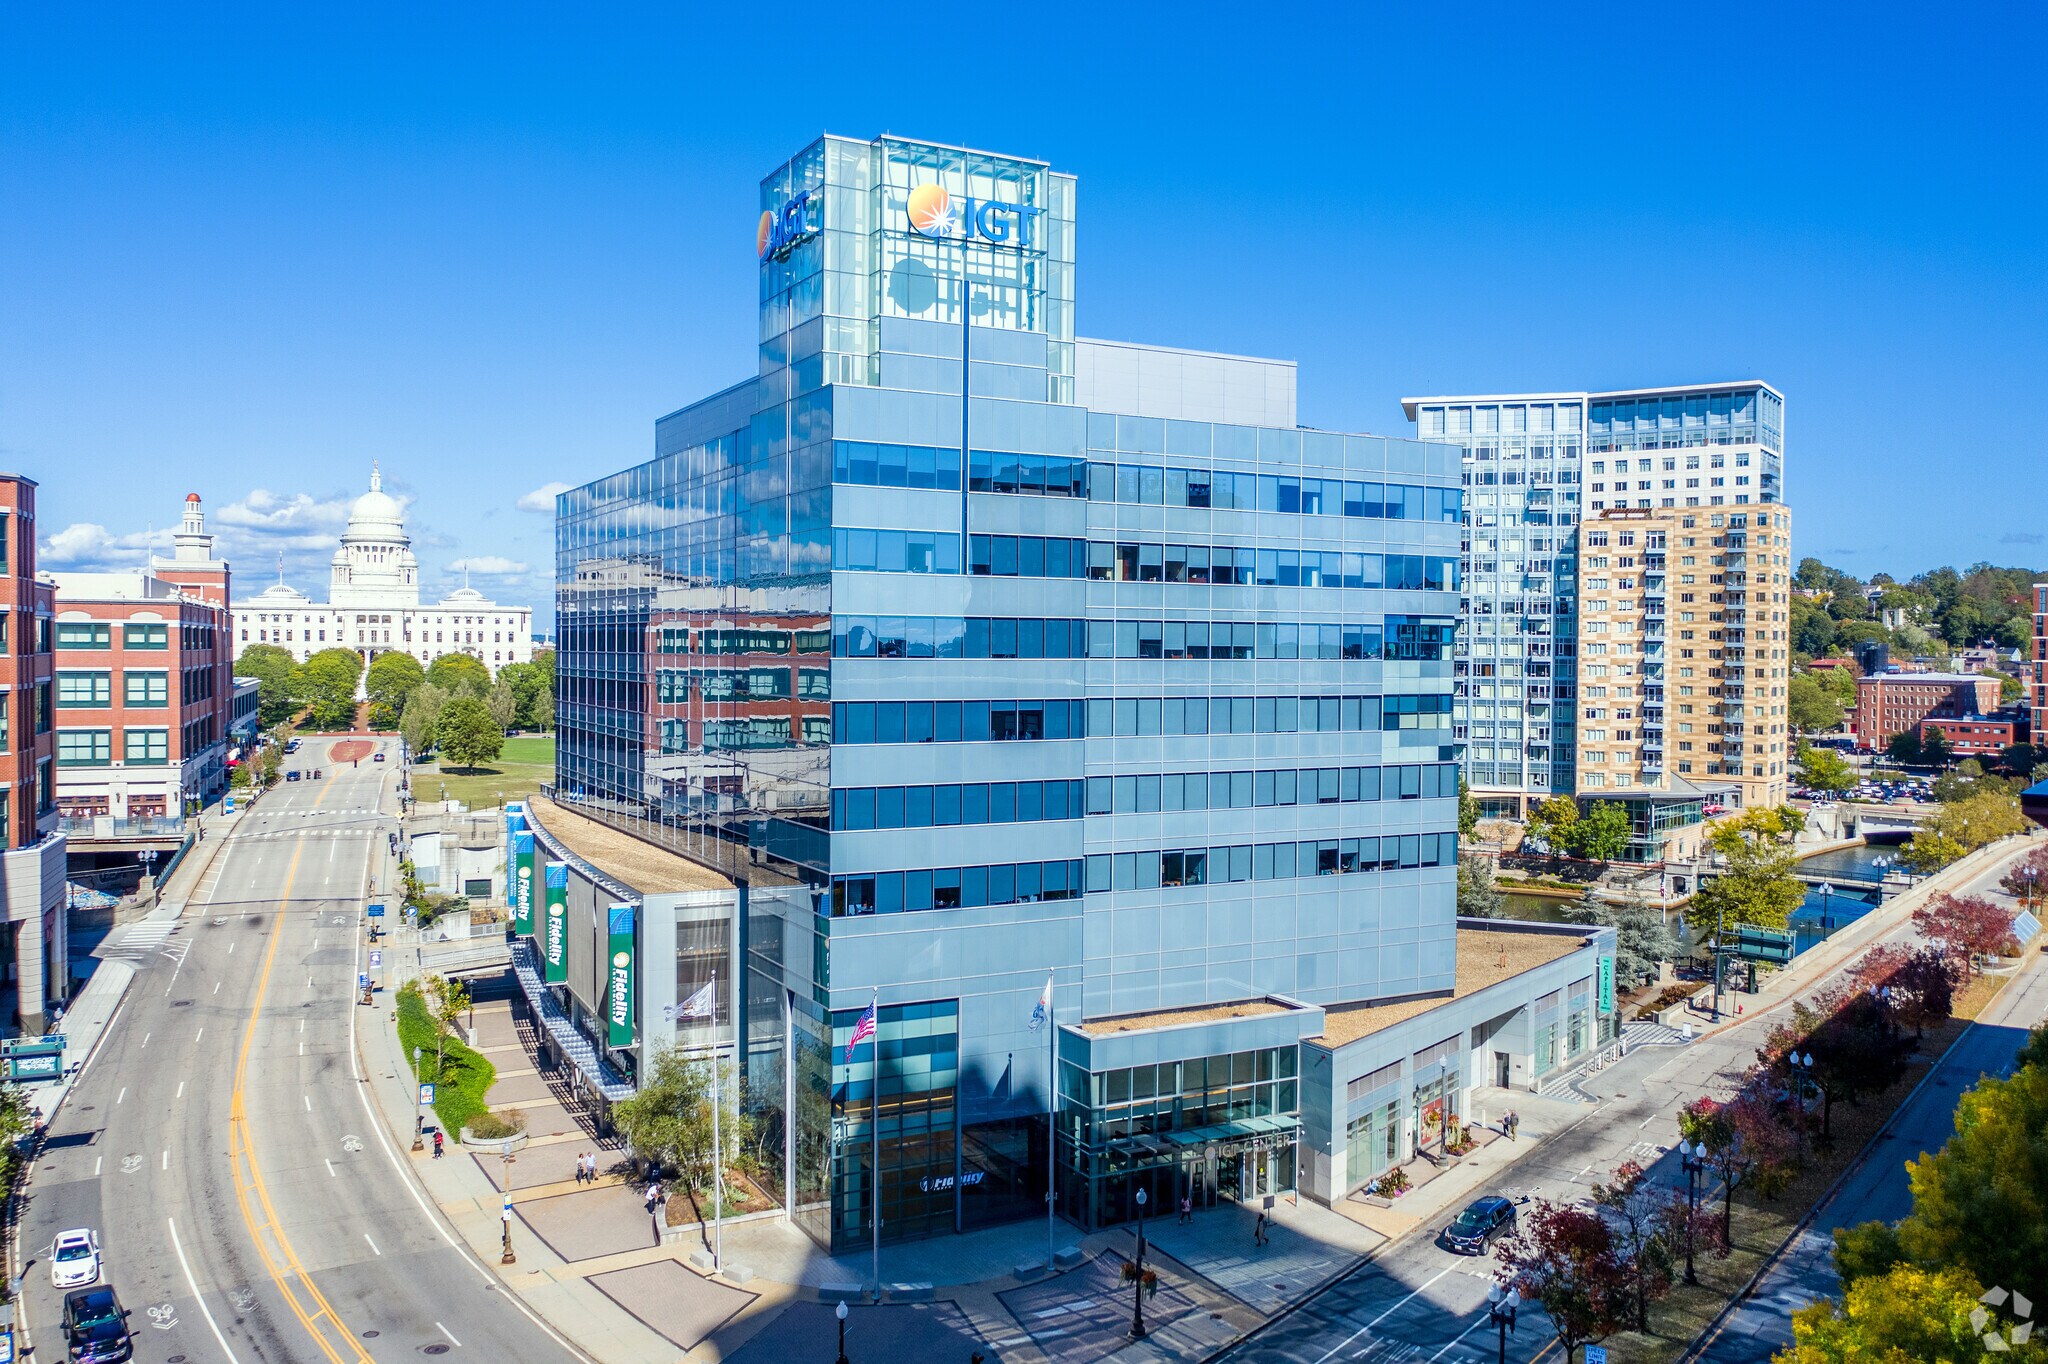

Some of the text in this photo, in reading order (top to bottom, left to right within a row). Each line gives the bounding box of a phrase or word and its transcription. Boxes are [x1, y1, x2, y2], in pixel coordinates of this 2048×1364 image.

[777, 190, 811, 248] IGT
[965, 197, 1038, 246] IGT
[518, 878, 530, 921] Fidelity
[549, 917, 563, 966] Fidelity
[612, 968, 628, 1027] Fidelity
[1218, 1134, 1291, 1158] IGT CENTER
[934, 1171, 985, 1188] Fidlity
[1587, 1346, 1605, 1355] SPEED
